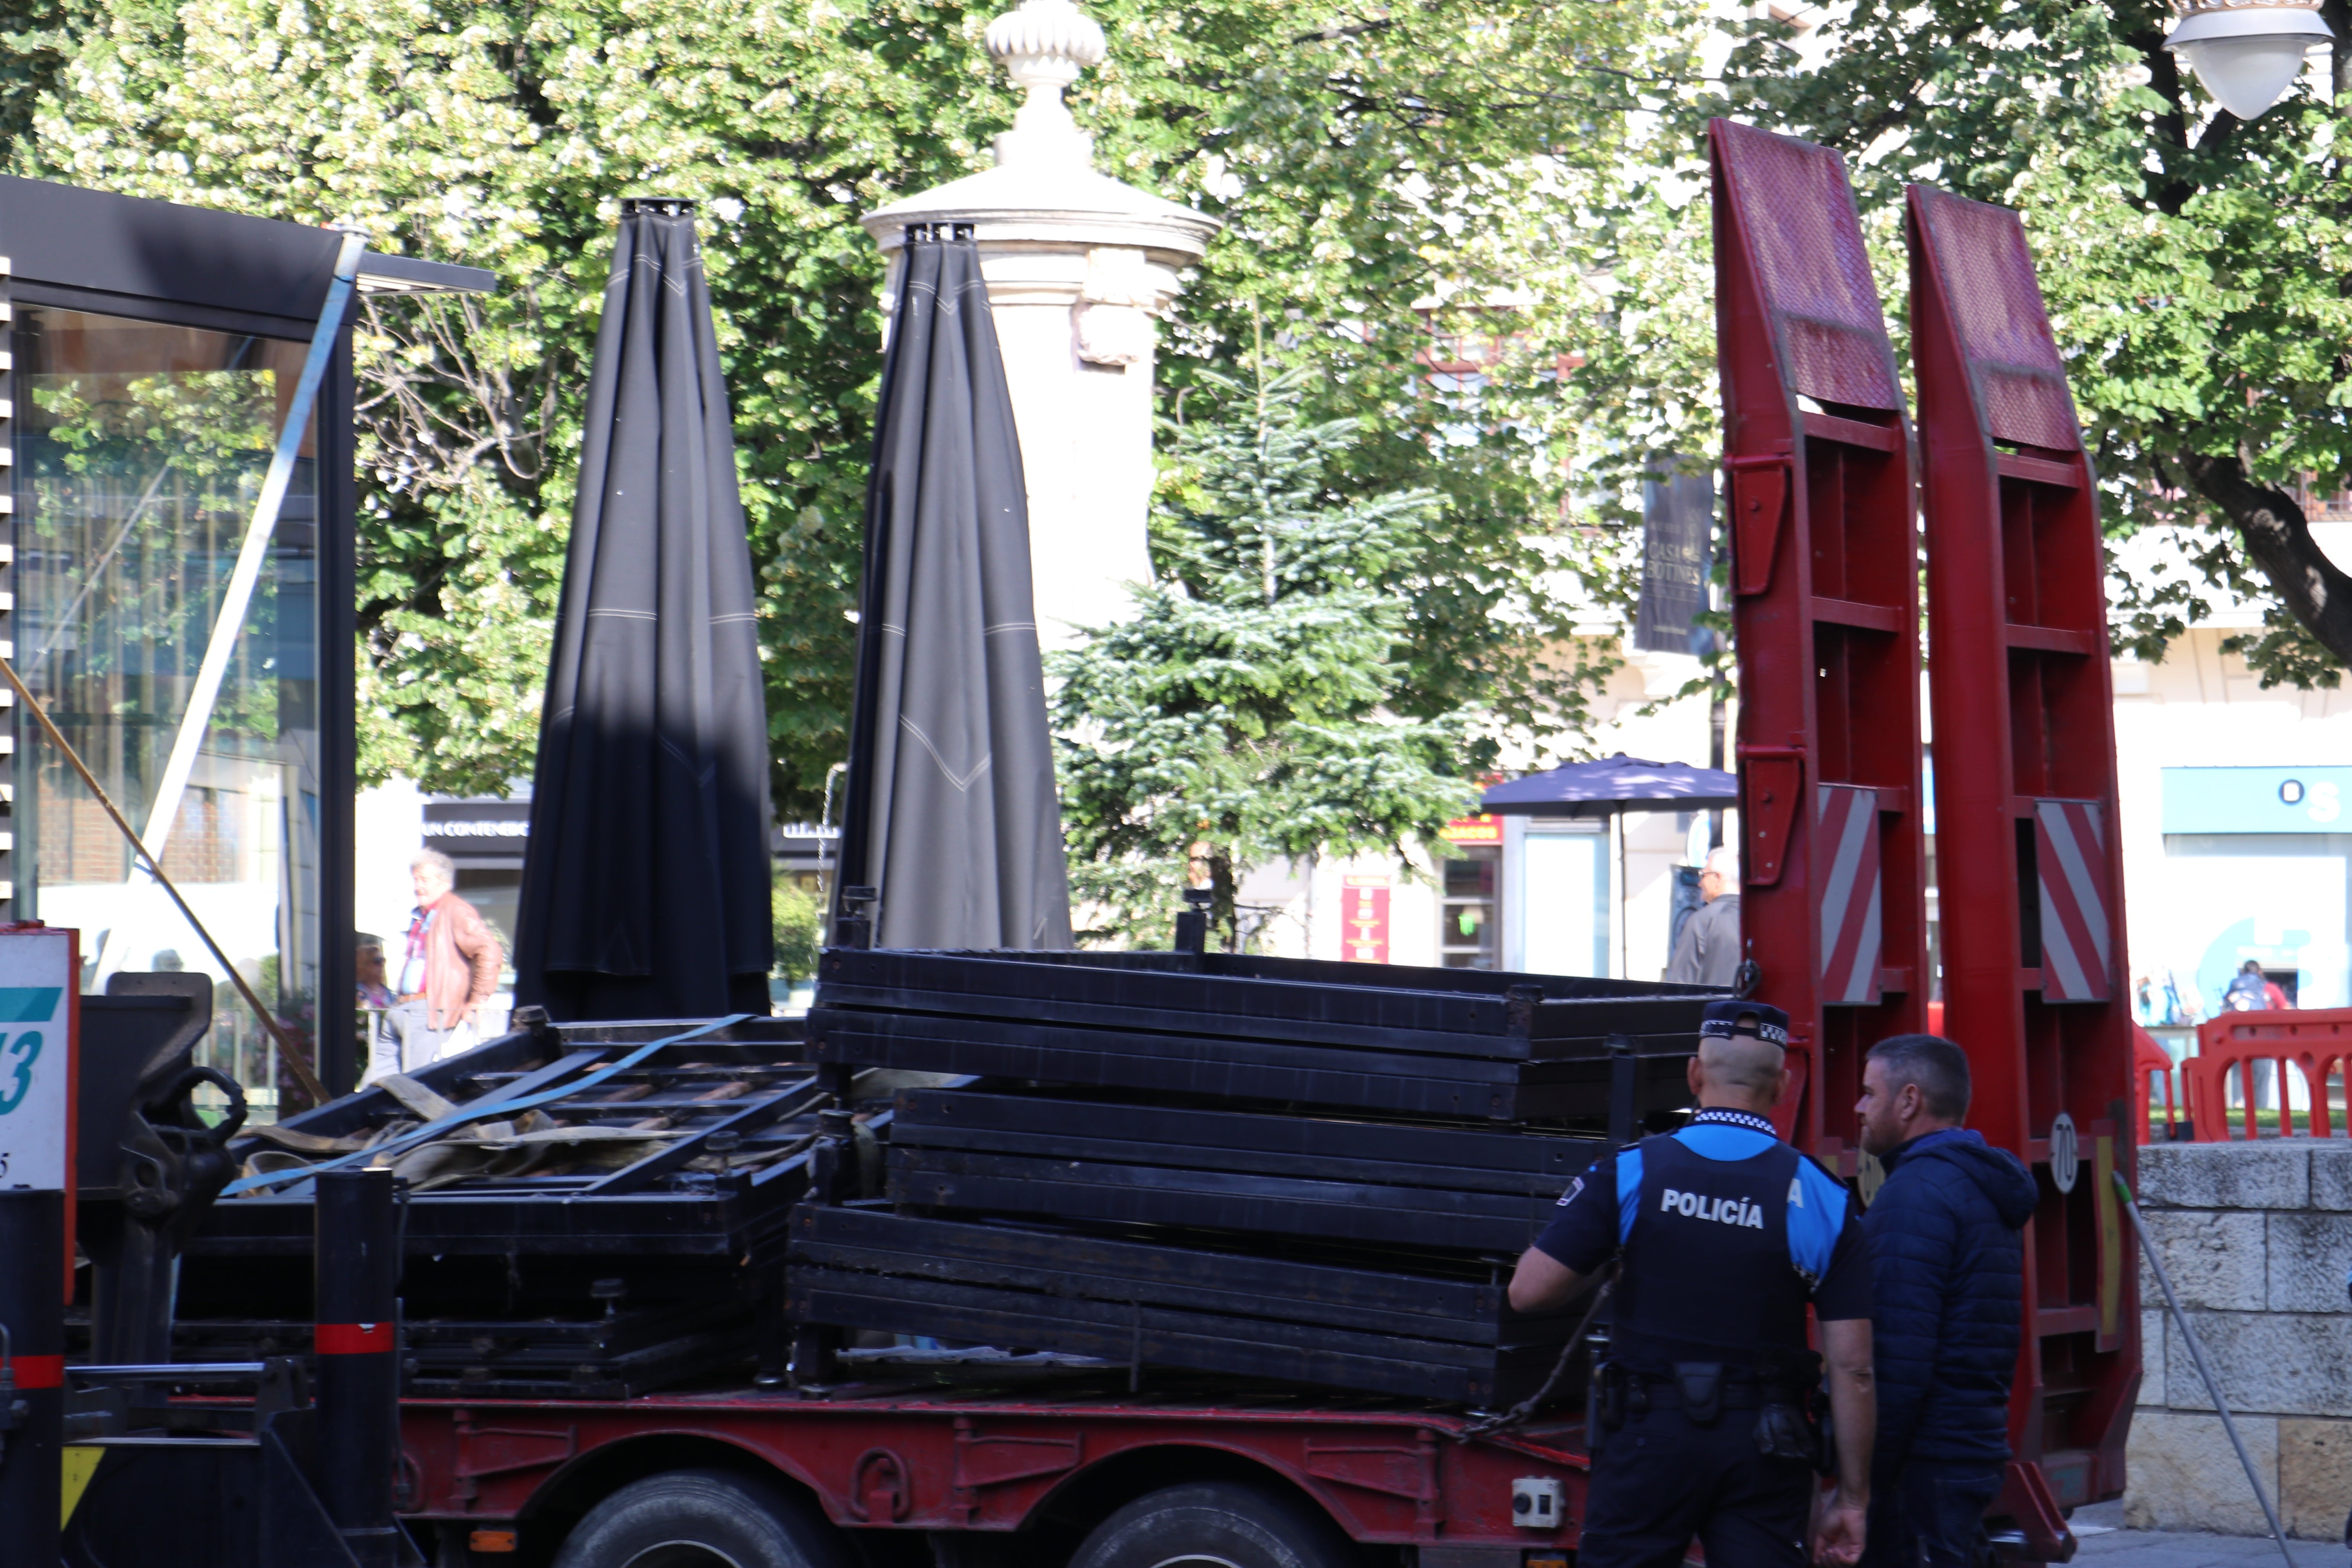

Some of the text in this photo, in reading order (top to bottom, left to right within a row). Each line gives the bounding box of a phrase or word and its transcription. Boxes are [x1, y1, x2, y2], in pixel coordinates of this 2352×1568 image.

[1646, 559, 1701, 586] BOTINES
[2055, 1123, 2075, 1182] 70
[1660, 1189, 1764, 1229] POLICÍA
